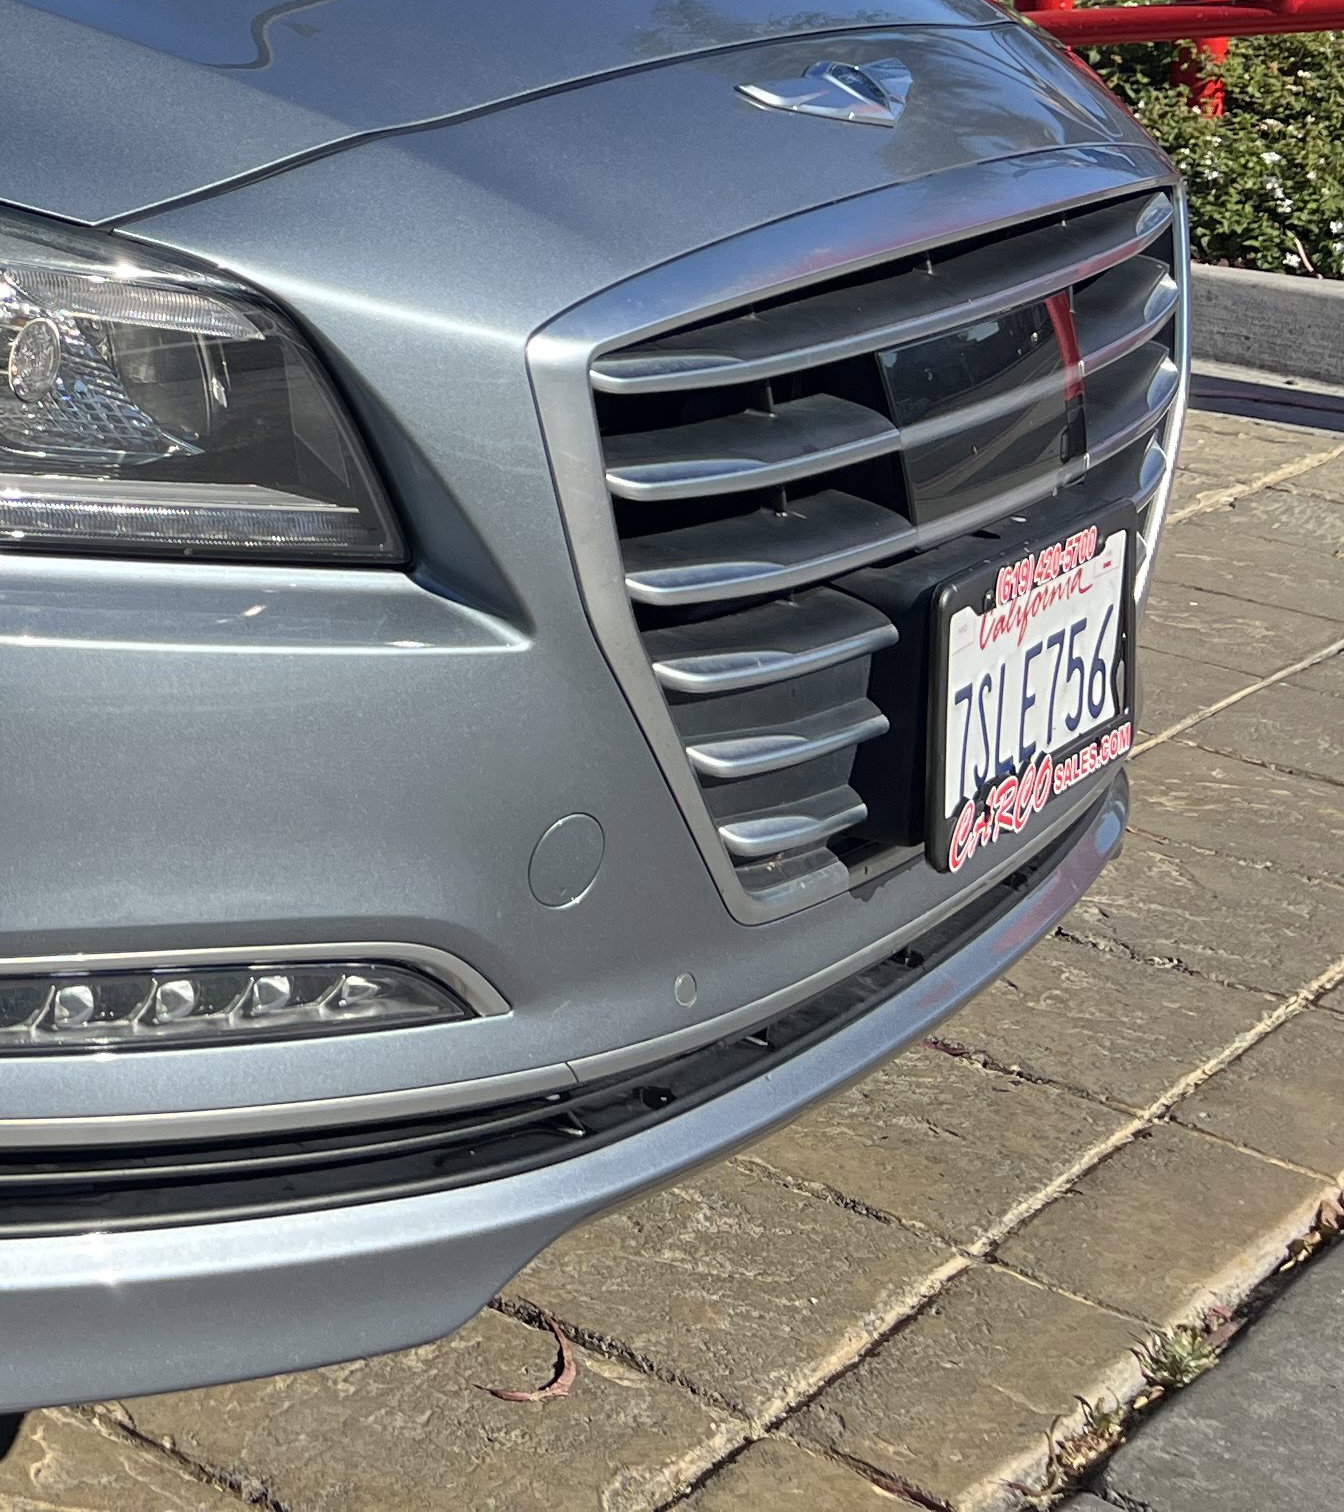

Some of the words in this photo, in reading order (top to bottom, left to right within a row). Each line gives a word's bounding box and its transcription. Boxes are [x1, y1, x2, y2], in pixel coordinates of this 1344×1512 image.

[979, 568, 1093, 649] California
[996, 553, 1035, 607] (619)
[954, 604, 1114, 803] 7SLE756
[1053, 721, 1132, 796] SALES.COM
